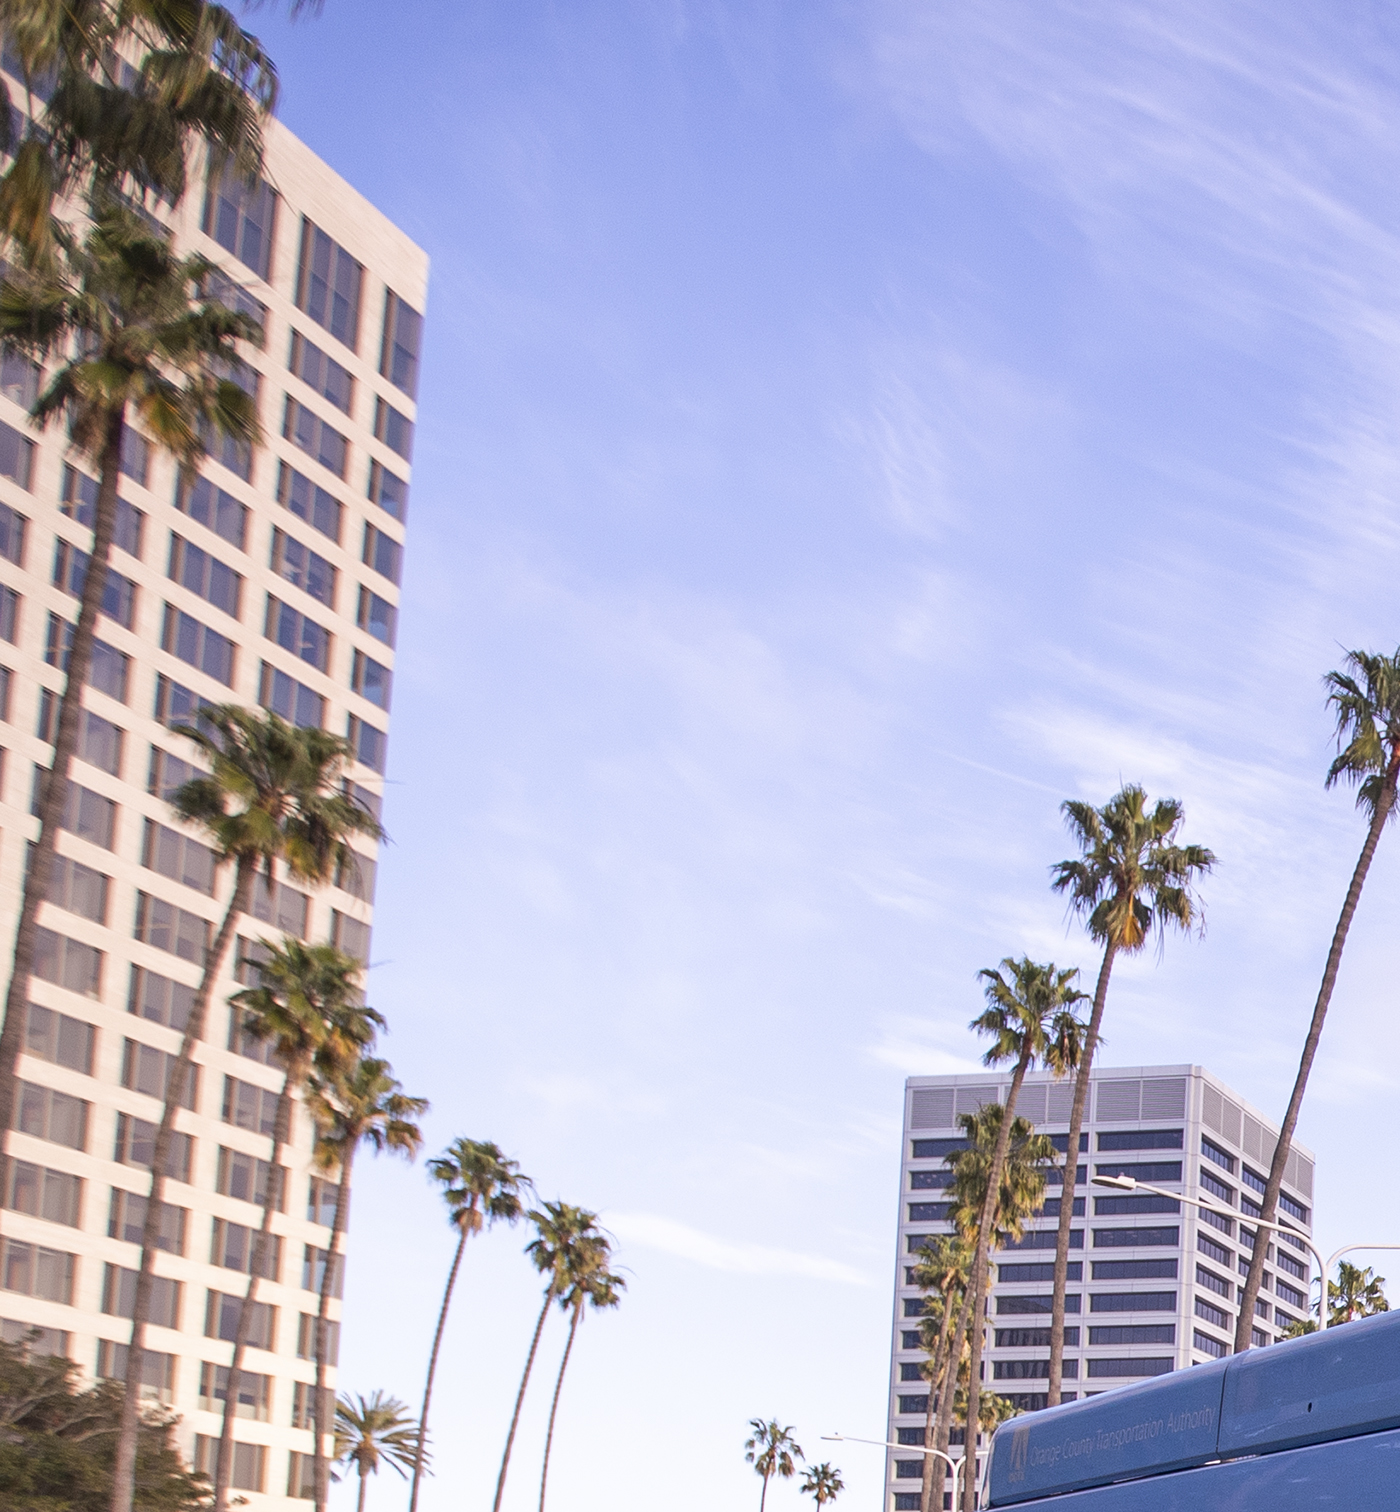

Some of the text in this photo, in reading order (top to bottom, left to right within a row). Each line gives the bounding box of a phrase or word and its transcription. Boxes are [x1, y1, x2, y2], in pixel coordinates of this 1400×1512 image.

[1029, 1404, 1216, 1468] Orange County Transportation Authority
